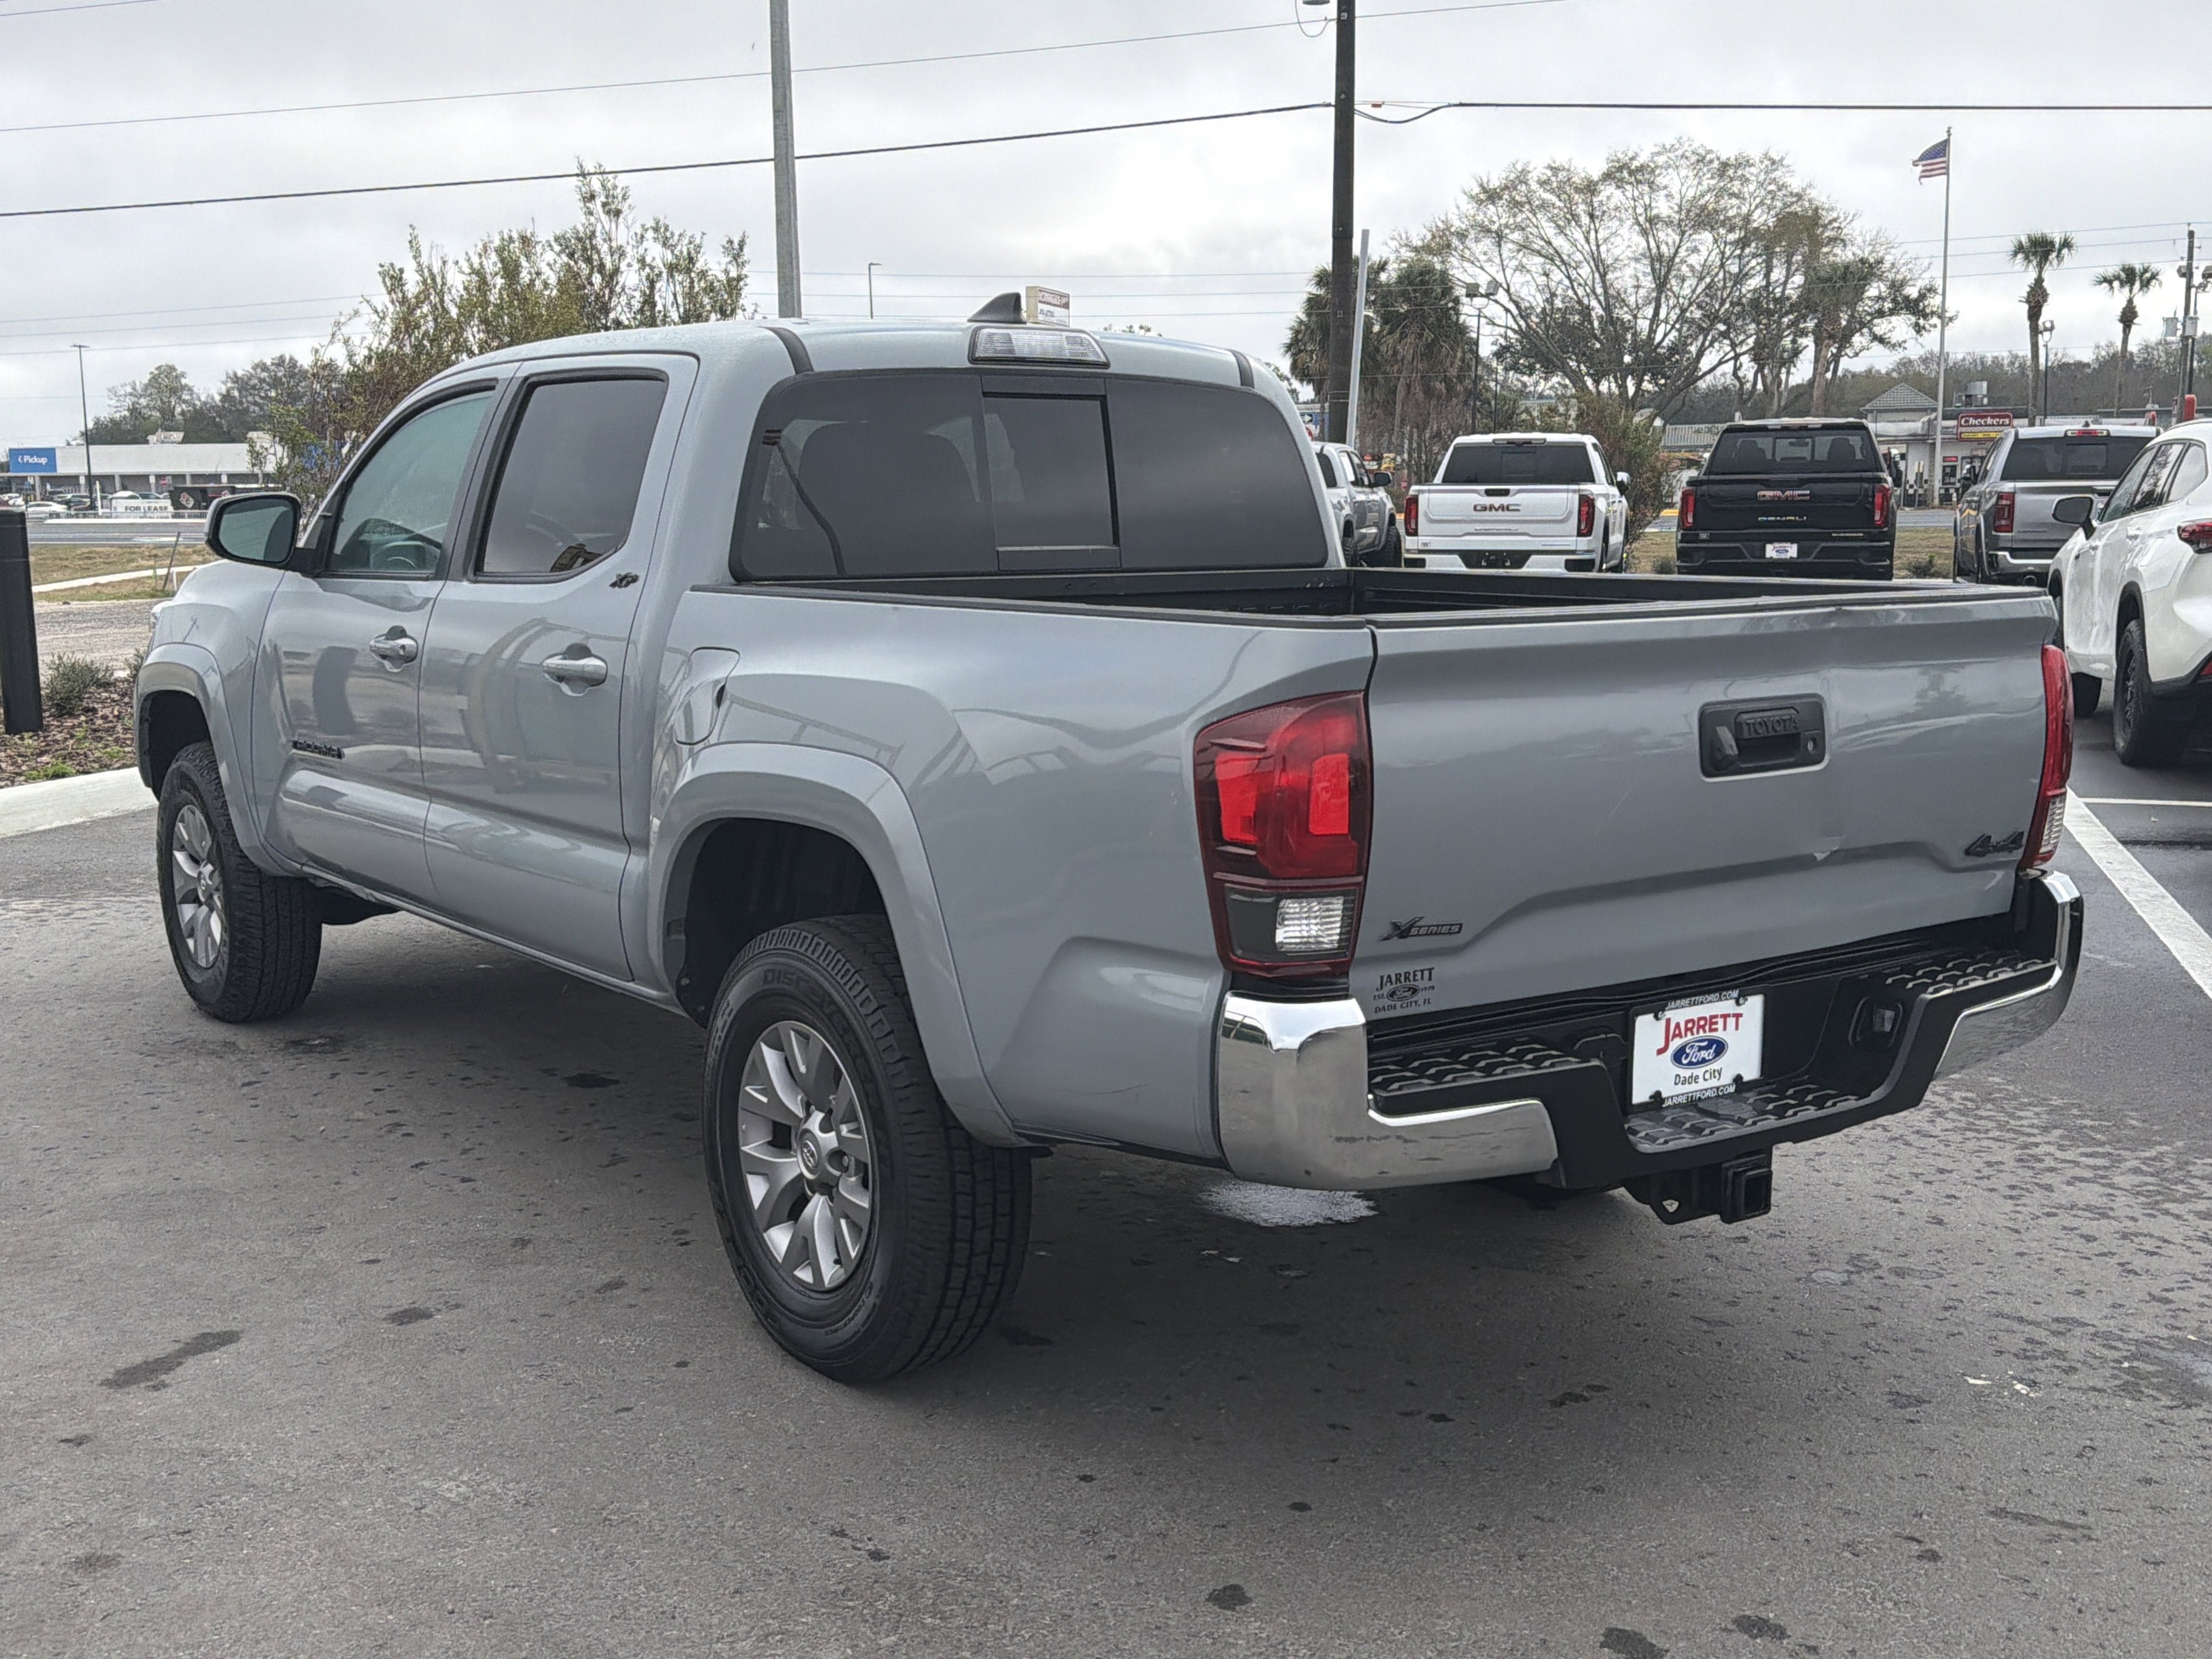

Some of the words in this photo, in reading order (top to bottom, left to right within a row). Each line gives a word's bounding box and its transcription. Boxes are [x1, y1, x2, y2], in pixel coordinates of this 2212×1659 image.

[1961, 417, 2010, 426] Checkers
[24, 455, 48, 465] Pickup
[1757, 490, 1810, 500] GMC
[1474, 504, 1521, 512] GMC
[1744, 715, 1798, 736] TOYOTA
[1408, 923, 1463, 937] SERIES
[1375, 967, 1435, 991] JARRETT
[1374, 1003, 1397, 1014] DADE
[1400, 1000, 1420, 1009] CITY,
[1665, 989, 1740, 1011] JARRETTFORD.COM
[1656, 1013, 1743, 1056] JARRETT
[1681, 1041, 1717, 1064] Ford
[1674, 1072, 1699, 1086] Dade
[1703, 1067, 1723, 1081] City
[1662, 1084, 1736, 1108] JARRETTFORD.COM
